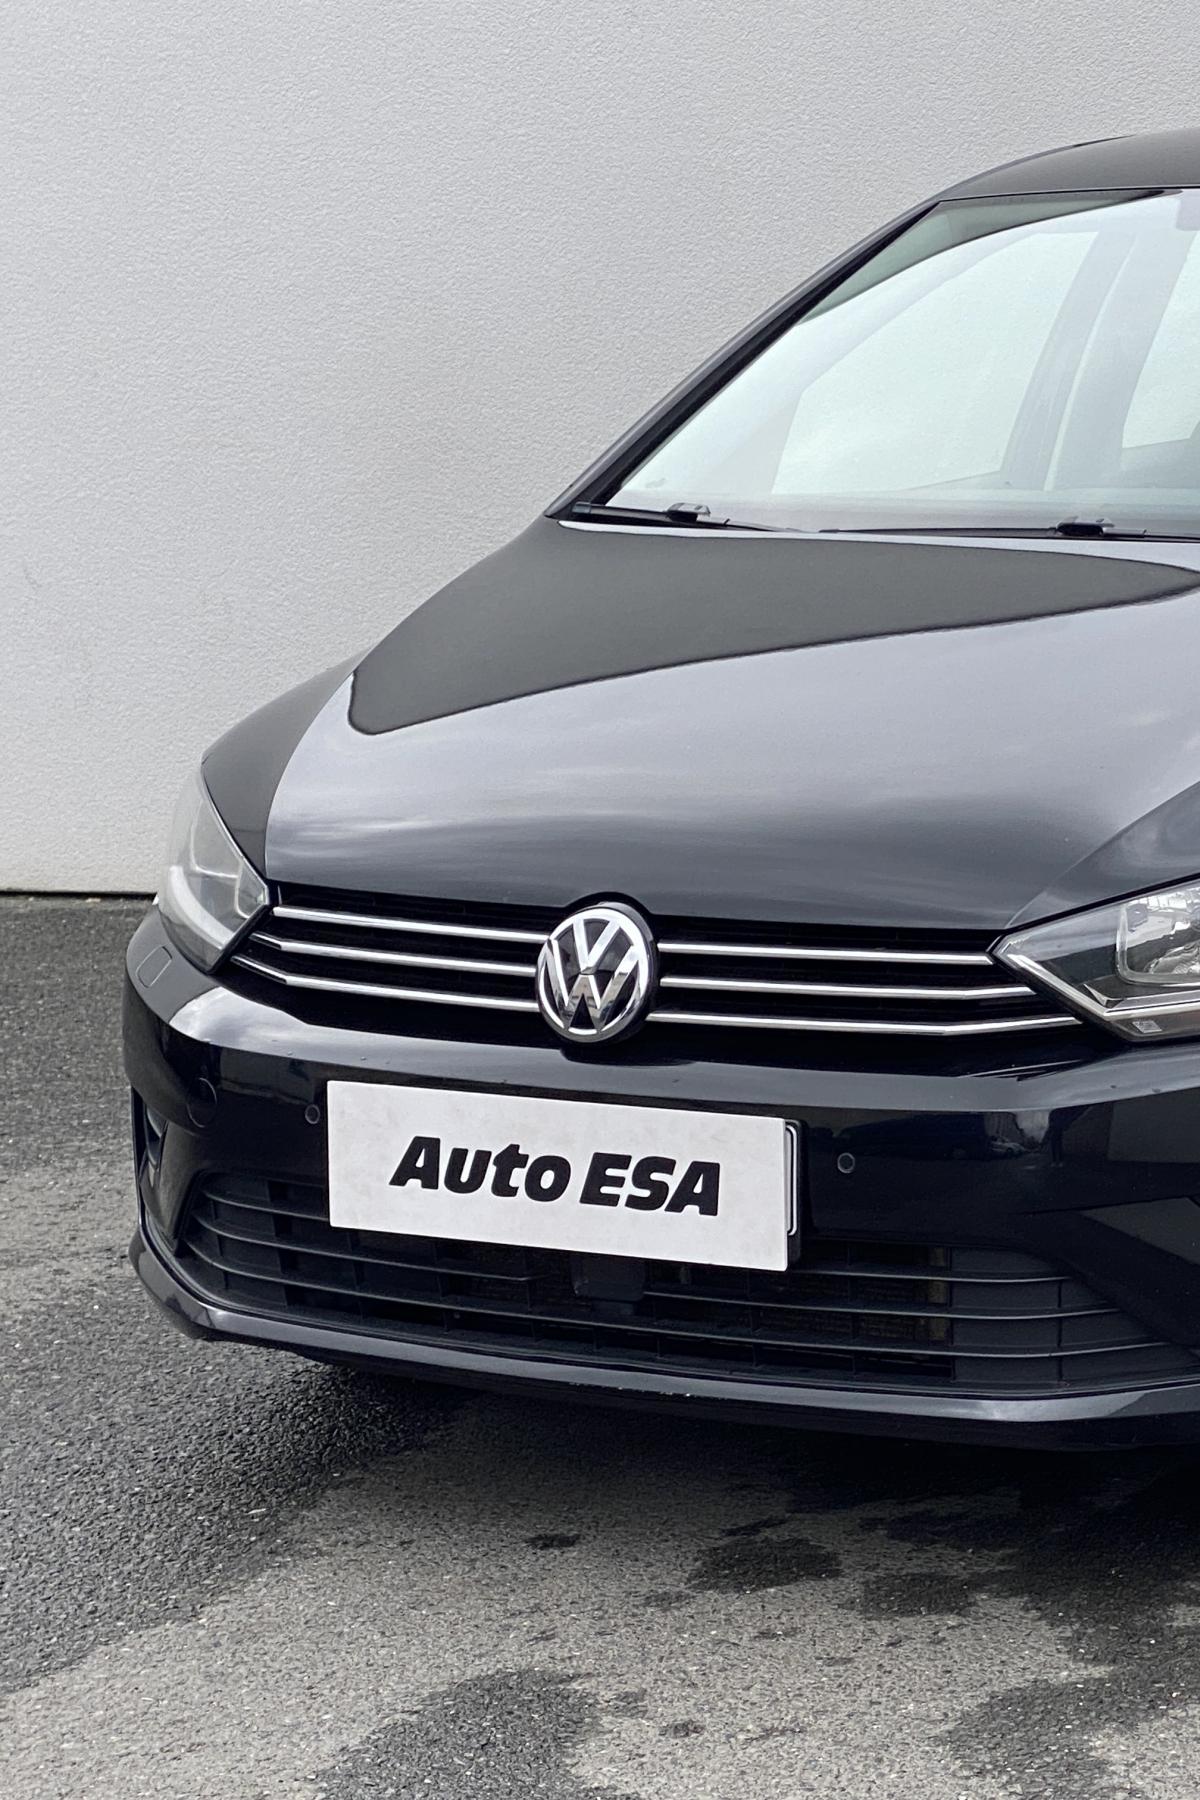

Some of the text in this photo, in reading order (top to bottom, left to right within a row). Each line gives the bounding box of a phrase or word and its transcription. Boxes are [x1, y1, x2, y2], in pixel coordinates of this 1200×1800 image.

[541, 907, 650, 1037] VW
[389, 1135, 720, 1216] Auto ESA
